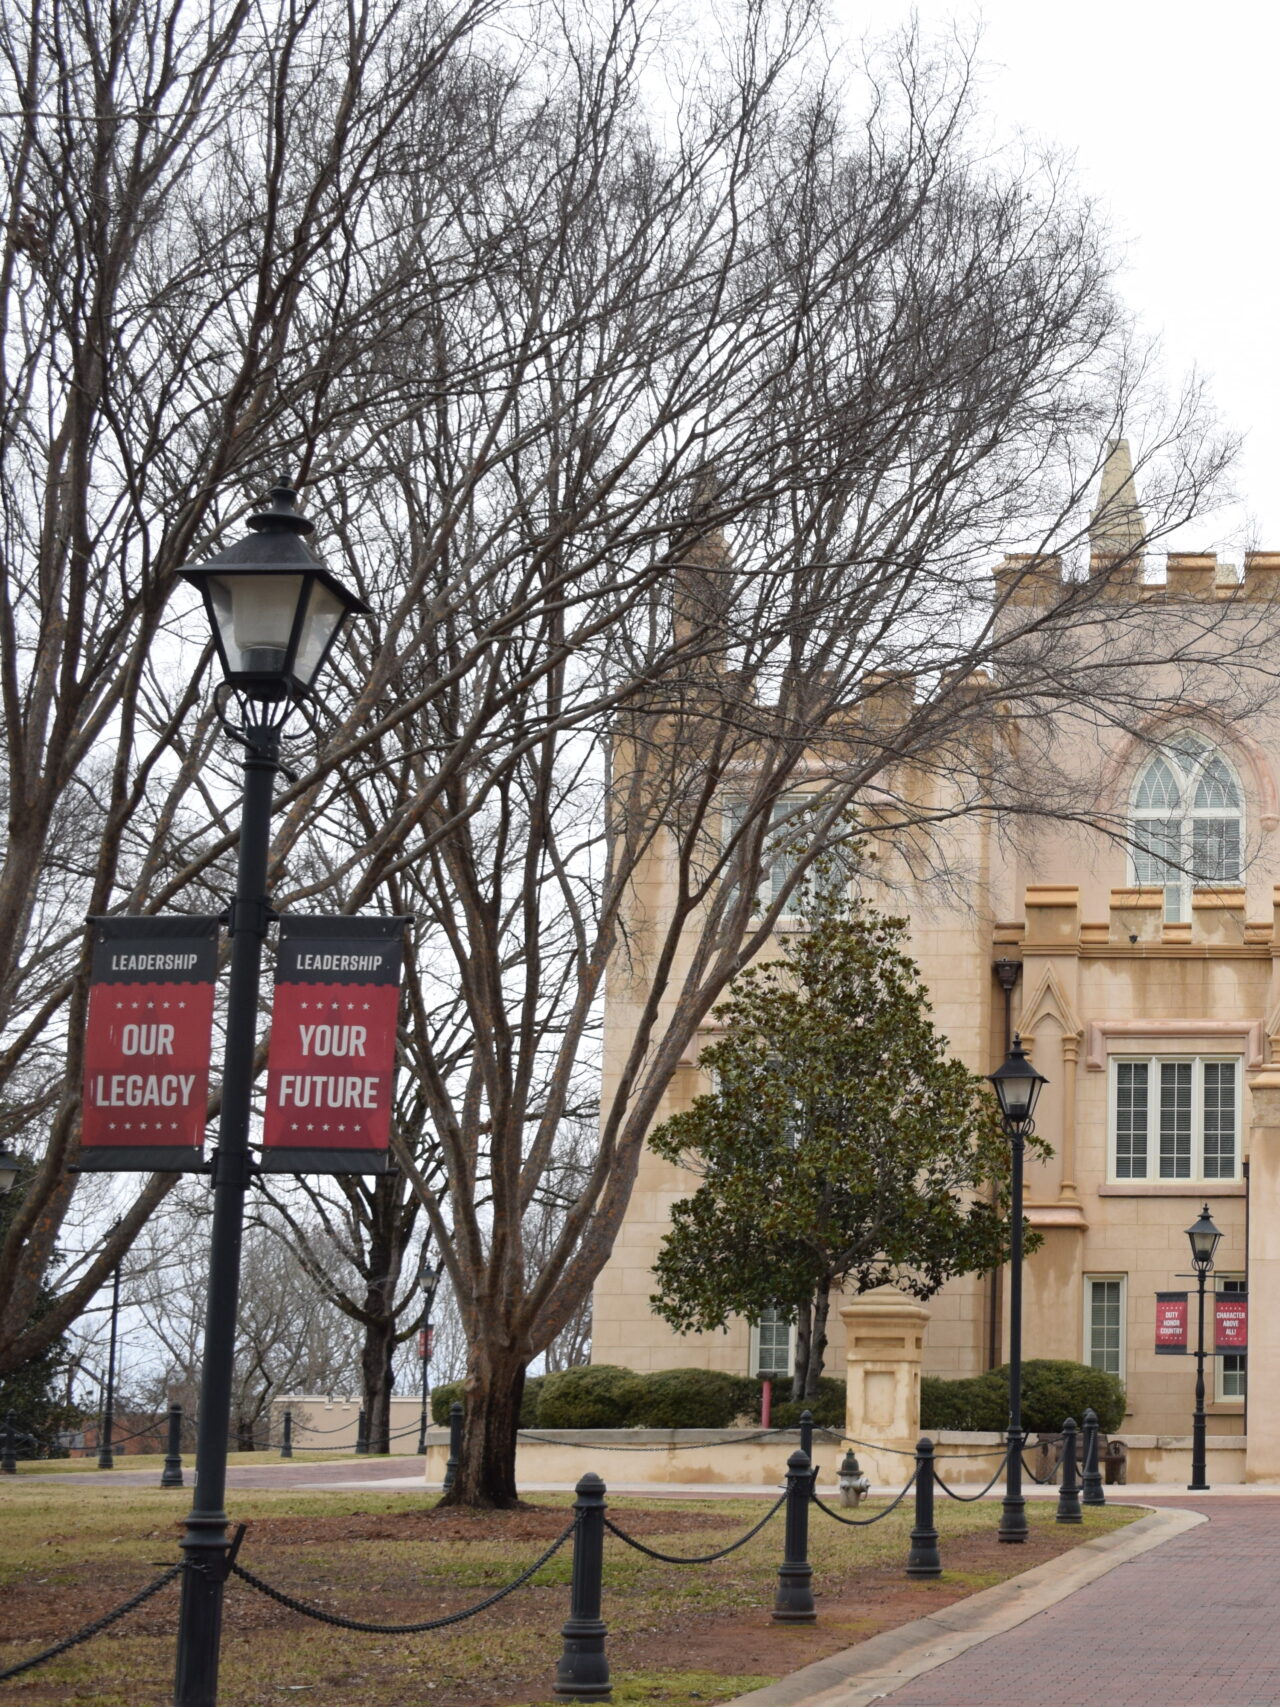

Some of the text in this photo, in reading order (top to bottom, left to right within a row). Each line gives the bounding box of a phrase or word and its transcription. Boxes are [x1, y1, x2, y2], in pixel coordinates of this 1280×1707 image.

[112, 954, 197, 971] LEADERSHIP
[296, 954, 382, 971] LEADERSHIP
[121, 1023, 175, 1056] OUR
[299, 1024, 367, 1057] YOUR
[96, 1074, 196, 1107] LEGACY
[278, 1075, 380, 1109] FUTURE
